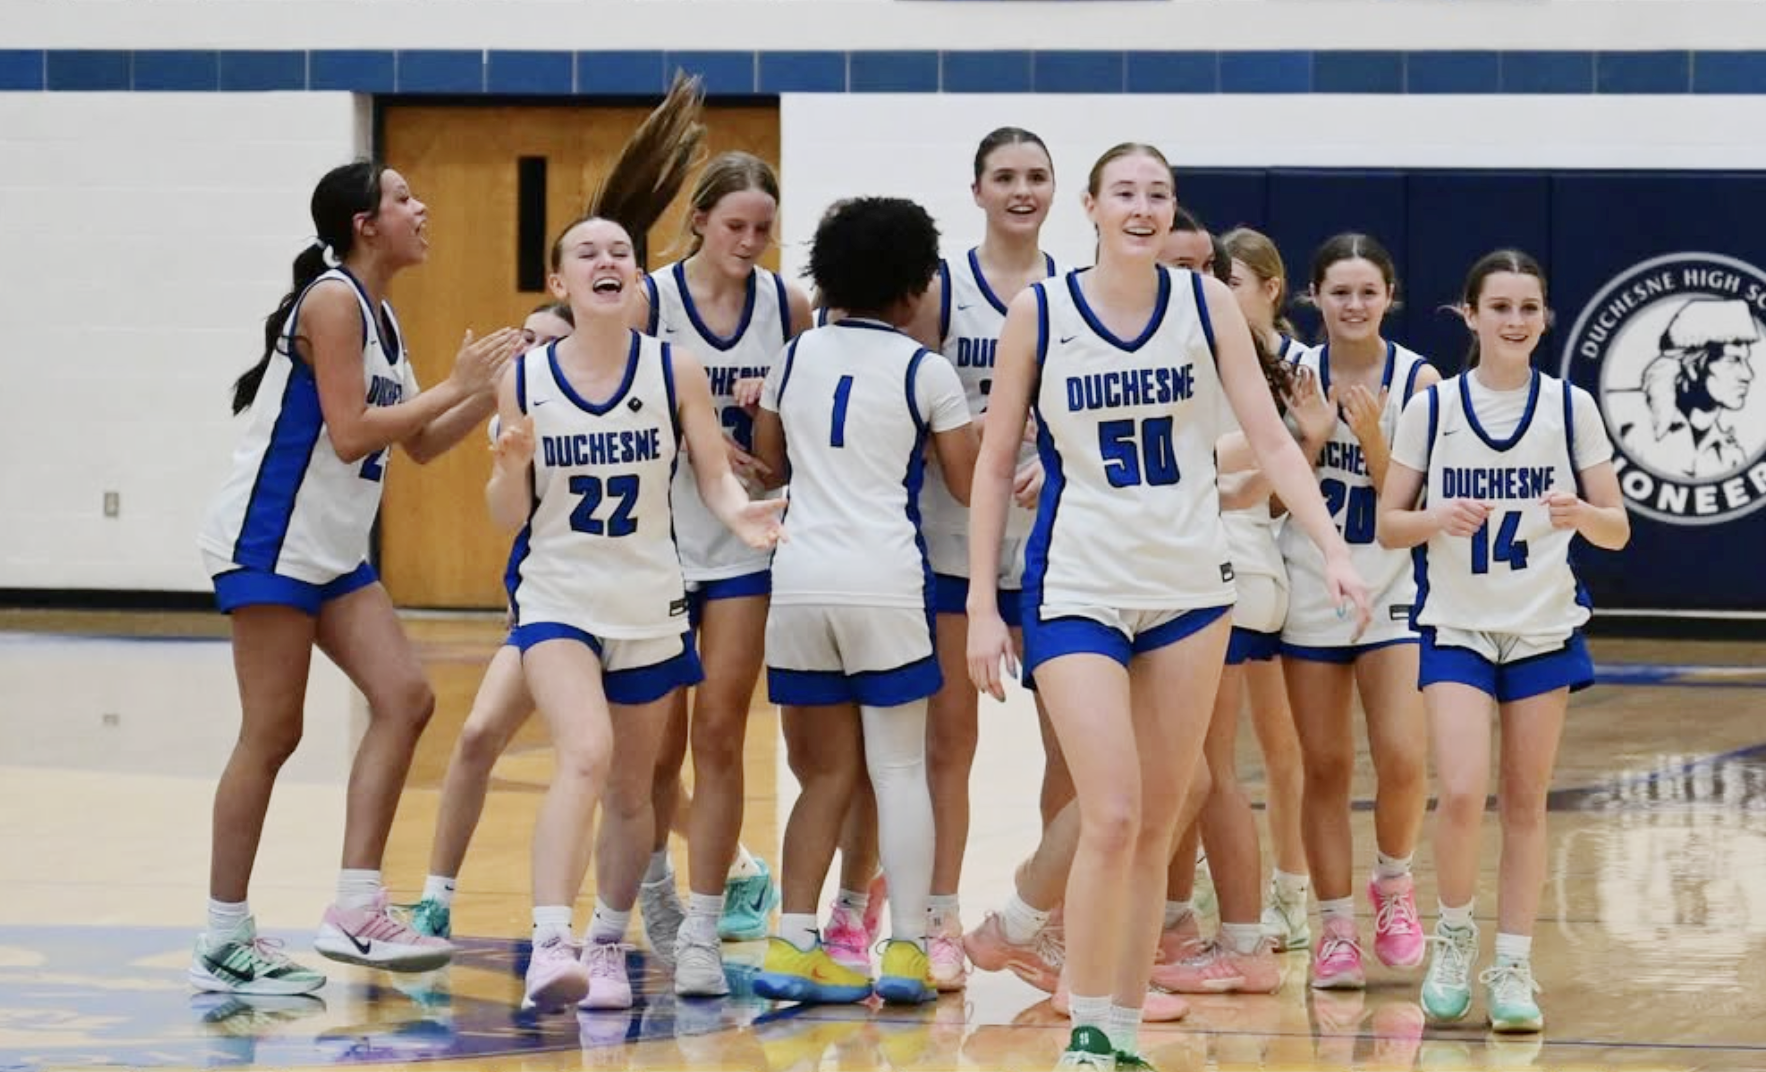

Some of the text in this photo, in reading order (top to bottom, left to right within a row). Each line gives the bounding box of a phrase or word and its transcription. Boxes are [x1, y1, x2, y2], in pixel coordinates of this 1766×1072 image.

[1581, 272, 1675, 359] DUCHESNE
[1683, 269, 1740, 293] HIGH
[830, 375, 854, 448] 1
[1066, 363, 1195, 412] DUCHESNE
[542, 427, 660, 467] DUCHESNE
[1098, 415, 1181, 488] 50
[569, 473, 640, 537] 22
[1320, 478, 1377, 544] 20
[1442, 466, 1555, 499] DUCHESNE
[1471, 510, 1529, 574] 14
